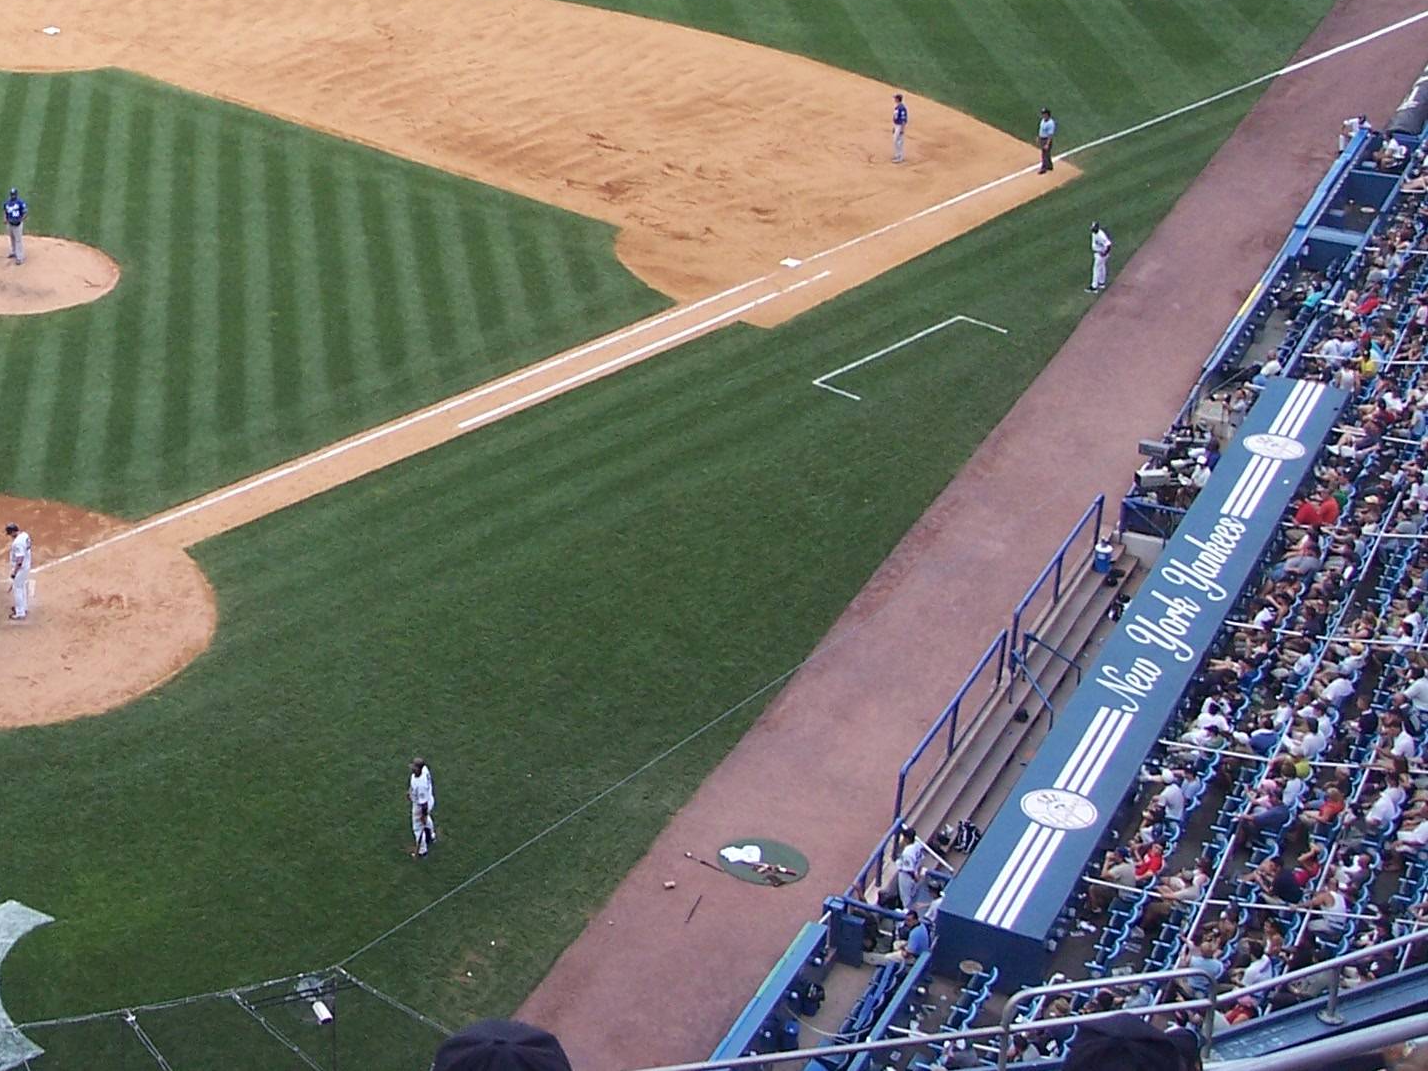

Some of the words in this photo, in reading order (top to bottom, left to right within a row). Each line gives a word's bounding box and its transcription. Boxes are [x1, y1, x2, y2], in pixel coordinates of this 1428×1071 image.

[1160, 516, 1248, 602] Yankees
[1125, 590, 1202, 663] York
[1095, 657, 1163, 713] New
